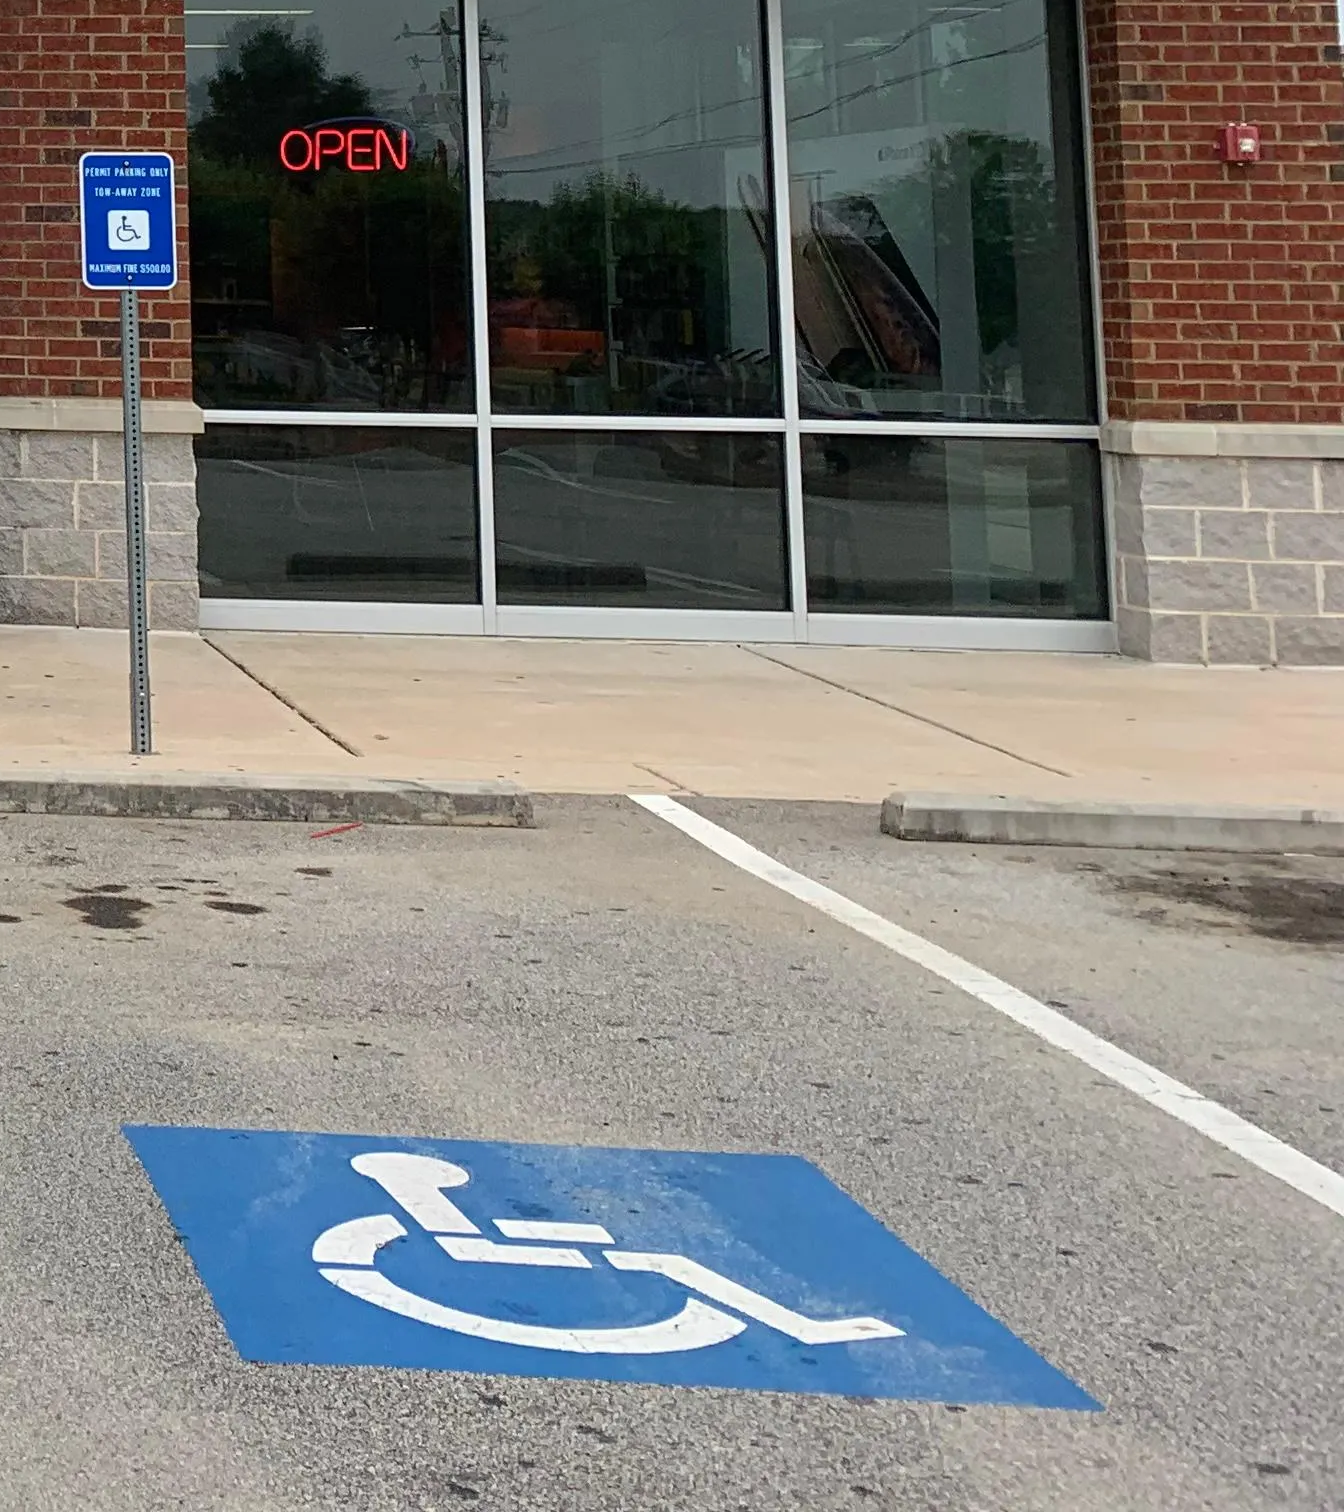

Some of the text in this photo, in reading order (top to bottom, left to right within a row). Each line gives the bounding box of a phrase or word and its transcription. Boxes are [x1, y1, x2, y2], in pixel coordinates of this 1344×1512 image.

[279, 128, 408, 171] OPEN
[85, 167, 169, 177] PERMIT PARKING ONLY
[94, 187, 161, 197] TOW-AWAY ZONE
[89, 263, 171, 274] MAXIMUM FINE $500.00
